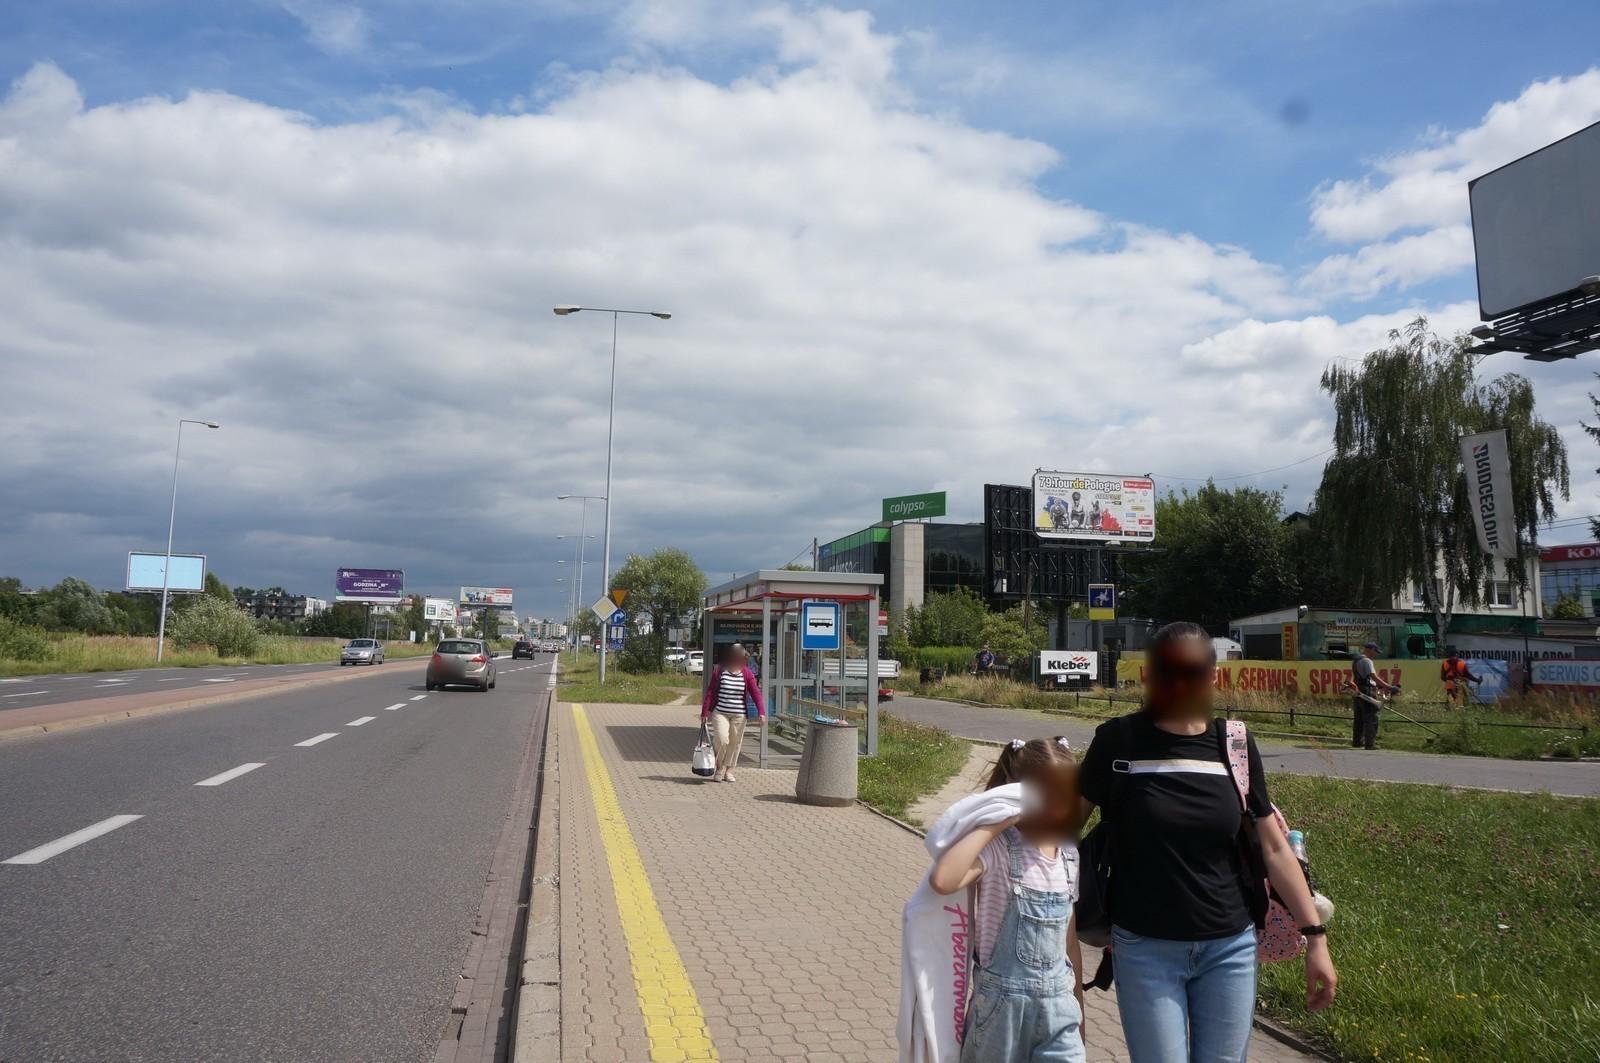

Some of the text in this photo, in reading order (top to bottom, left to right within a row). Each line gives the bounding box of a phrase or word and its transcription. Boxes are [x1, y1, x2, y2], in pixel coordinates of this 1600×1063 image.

[889, 500, 925, 515] calypso
[1338, 616, 1392, 625] WULKANIZACJA
[1048, 661, 1091, 670] Kleber
[1240, 667, 1298, 692] SERWIS
[1539, 665, 1589, 682] SERWIS
